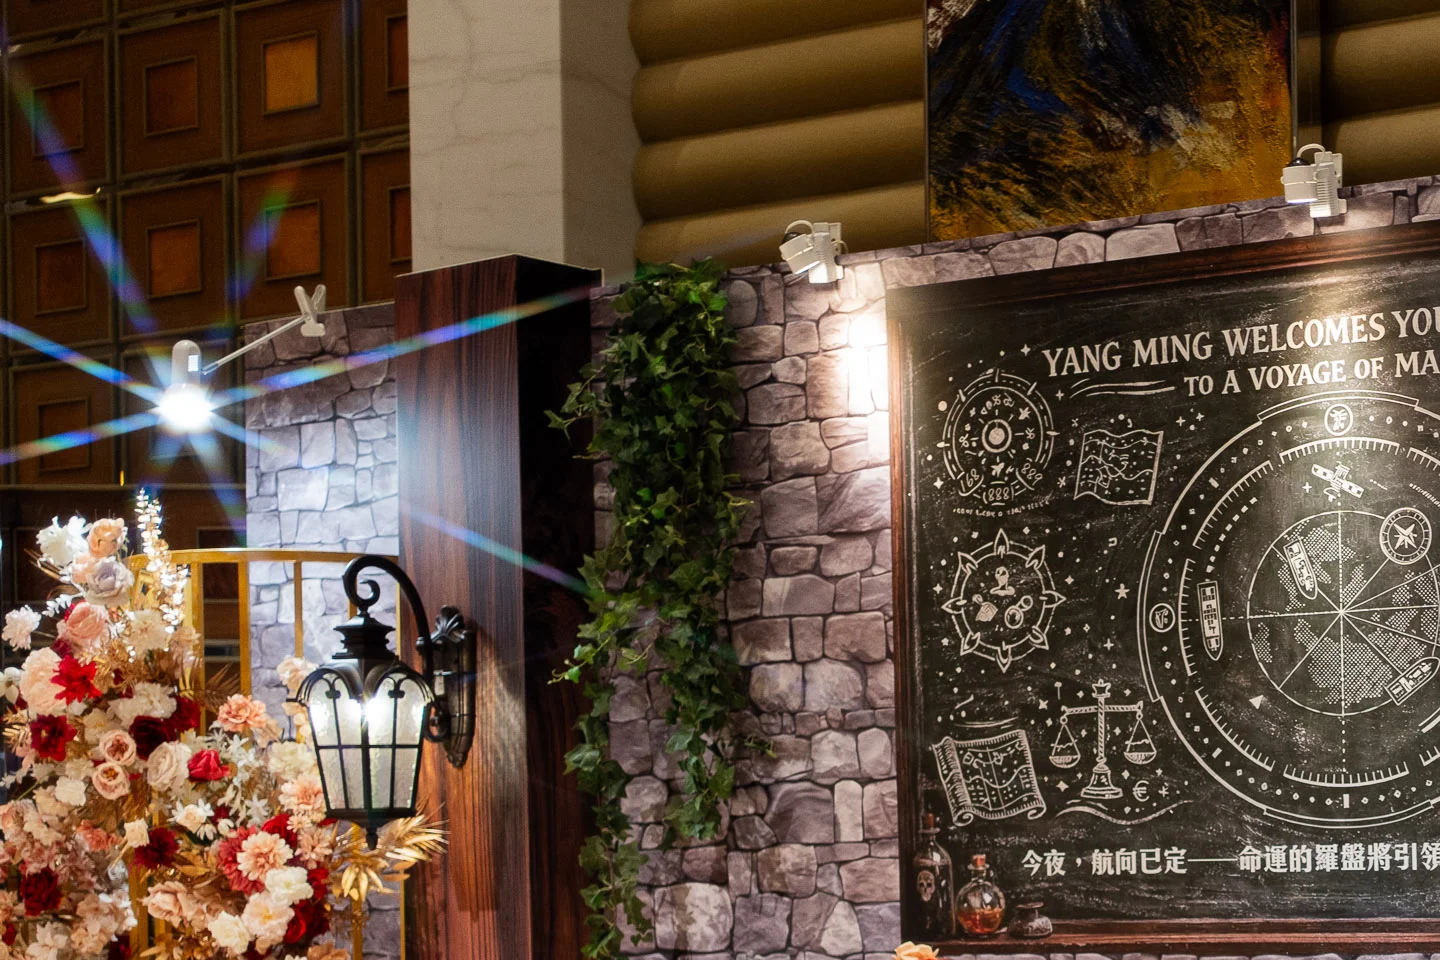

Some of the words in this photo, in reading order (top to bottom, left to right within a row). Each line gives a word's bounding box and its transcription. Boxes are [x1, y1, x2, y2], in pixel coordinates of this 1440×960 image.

[1041, 341, 1122, 377] YANG
[1132, 331, 1214, 368] MING
[1221, 312, 1386, 357] WELCOMES
[1184, 374, 1214, 397] TO
[1222, 369, 1242, 395] A
[1248, 360, 1347, 391] VOYAGE
[1354, 356, 1385, 380] OF
